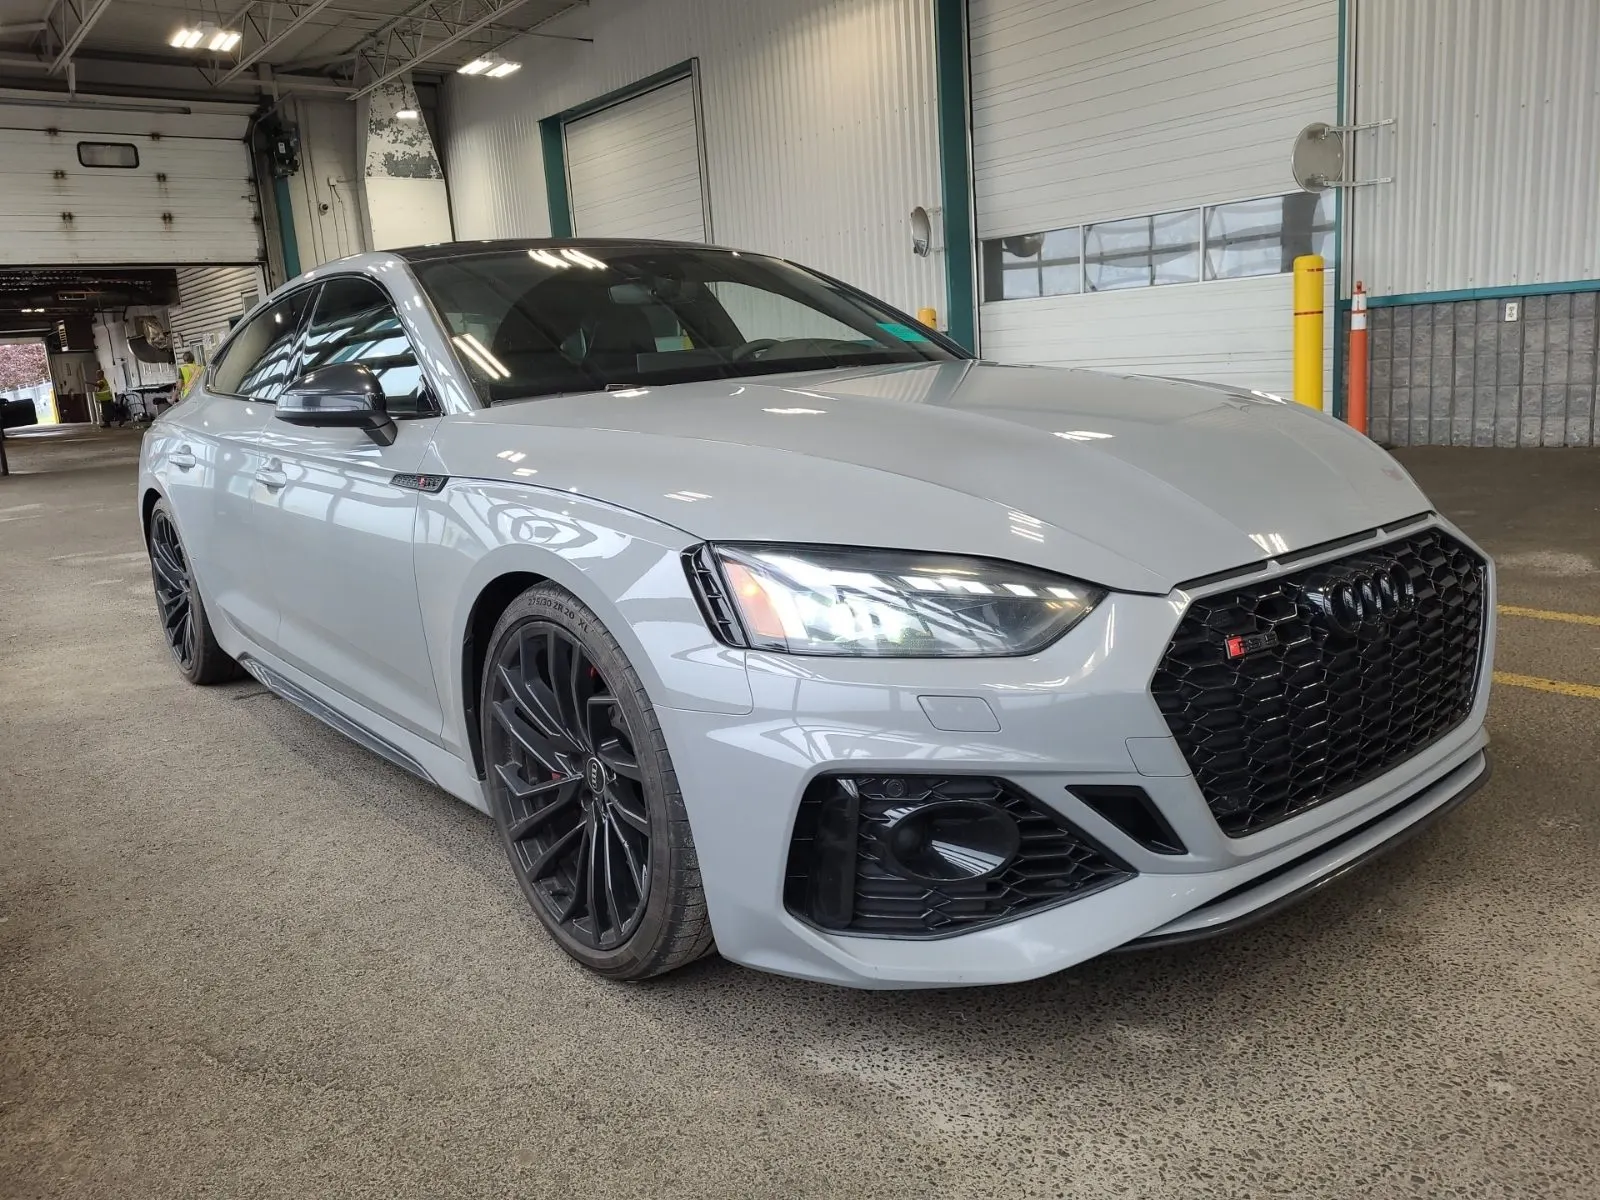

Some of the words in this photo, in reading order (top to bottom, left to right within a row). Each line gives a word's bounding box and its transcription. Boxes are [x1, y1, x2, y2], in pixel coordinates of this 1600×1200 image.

[528, 598, 552, 607] 275/30
[552, 602, 563, 612] ZR
[564, 608, 575, 619] 20
[578, 618, 589, 633] XL
